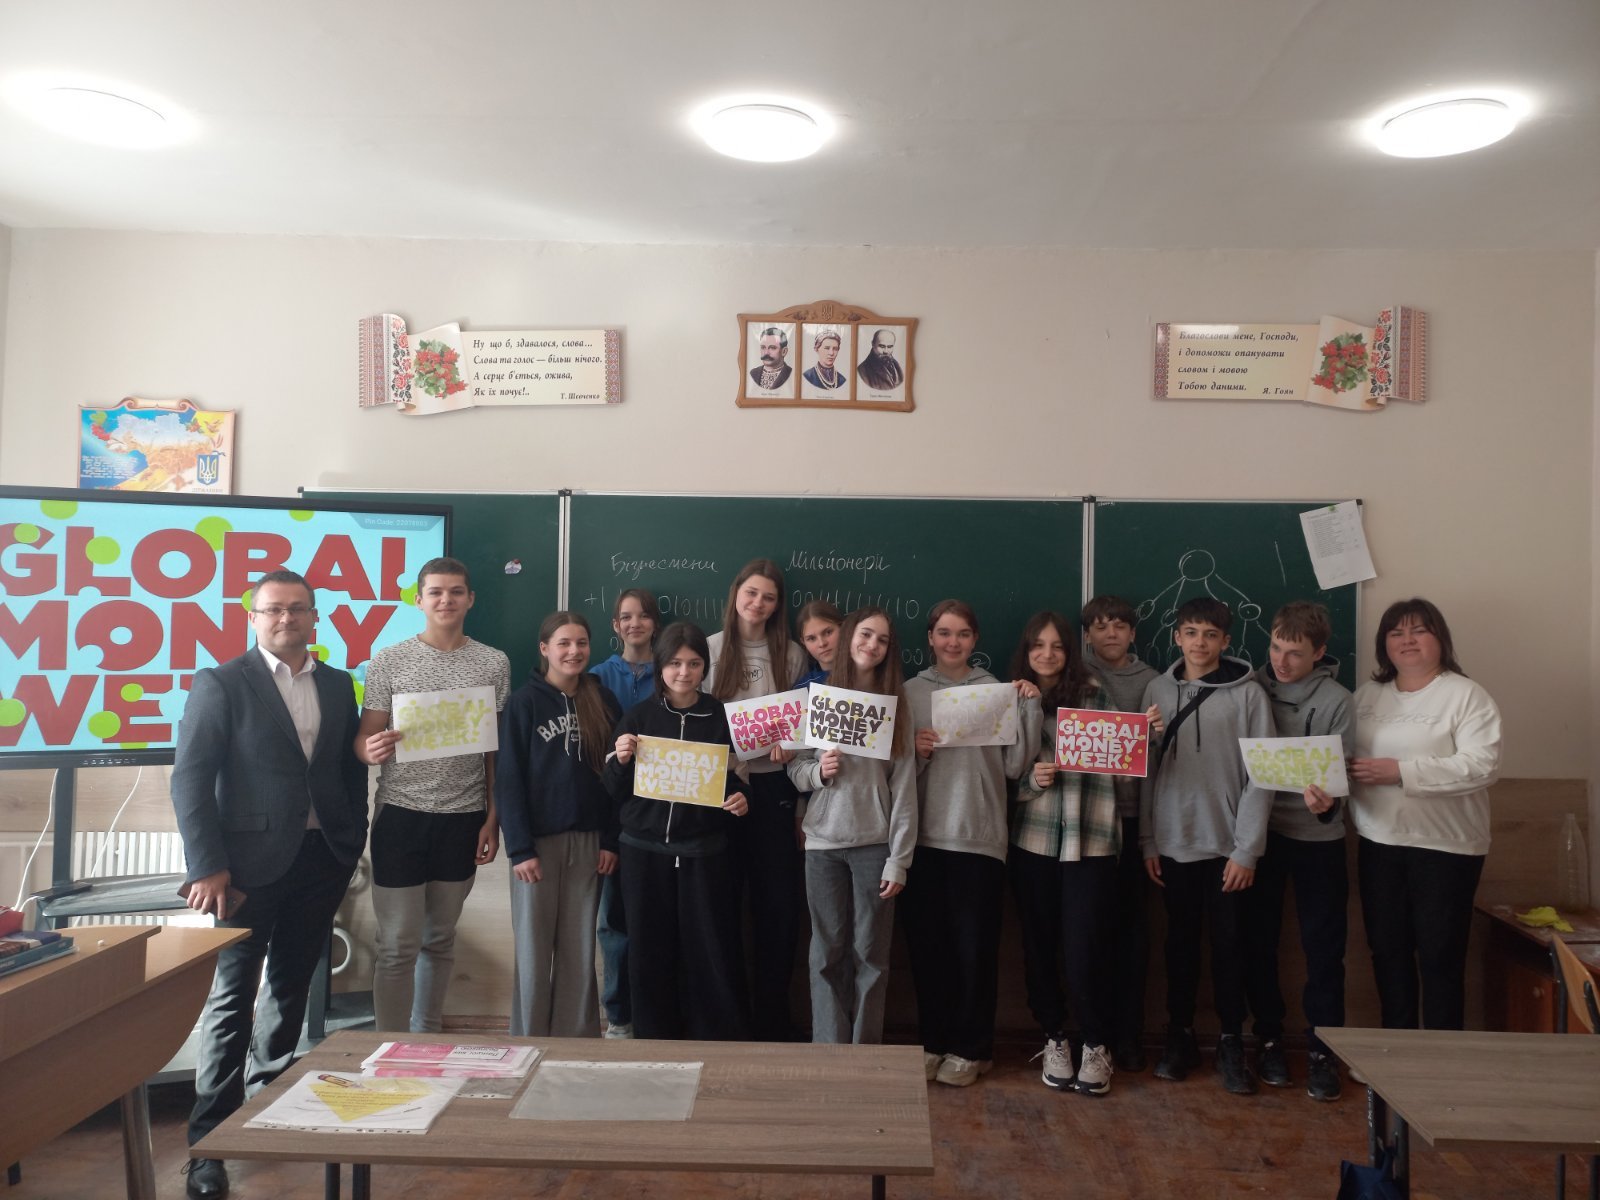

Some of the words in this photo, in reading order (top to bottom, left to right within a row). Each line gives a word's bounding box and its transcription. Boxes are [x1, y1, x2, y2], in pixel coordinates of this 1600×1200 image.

[473, 339, 485, 351] Ну
[490, 341, 502, 350] що
[505, 338, 513, 349] б,
[516, 338, 558, 349] здавалося,
[1179, 331, 1229, 340] Благослови
[1260, 331, 1298, 342] Господи,
[473, 355, 498, 364] Слова
[547, 354, 571, 363] більш
[574, 354, 602, 363] нічого.
[1185, 347, 1231, 356] допоможи
[1234, 350, 1285, 359] опанувати
[473, 371, 480, 380] А
[483, 373, 505, 383] серце
[544, 372, 573, 380] ожива,
[1178, 381, 1207, 390] Тобою
[474, 387, 485, 396] Як
[488, 387, 496, 396] їх
[499, 386, 530, 398] почує!..
[568, 392, 600, 400] Шевченко
[733, 714, 802, 741] MONEY
[810, 708, 885, 735] MONEY
[1059, 718, 1142, 740] GLOBAL
[736, 728, 794, 752] WEEK
[809, 722, 867, 748] WEEK
[1058, 735, 1138, 755] MONEY
[1058, 751, 1123, 770] WEEK
[637, 763, 717, 785] MONEY
[637, 776, 700, 799] WEEK
